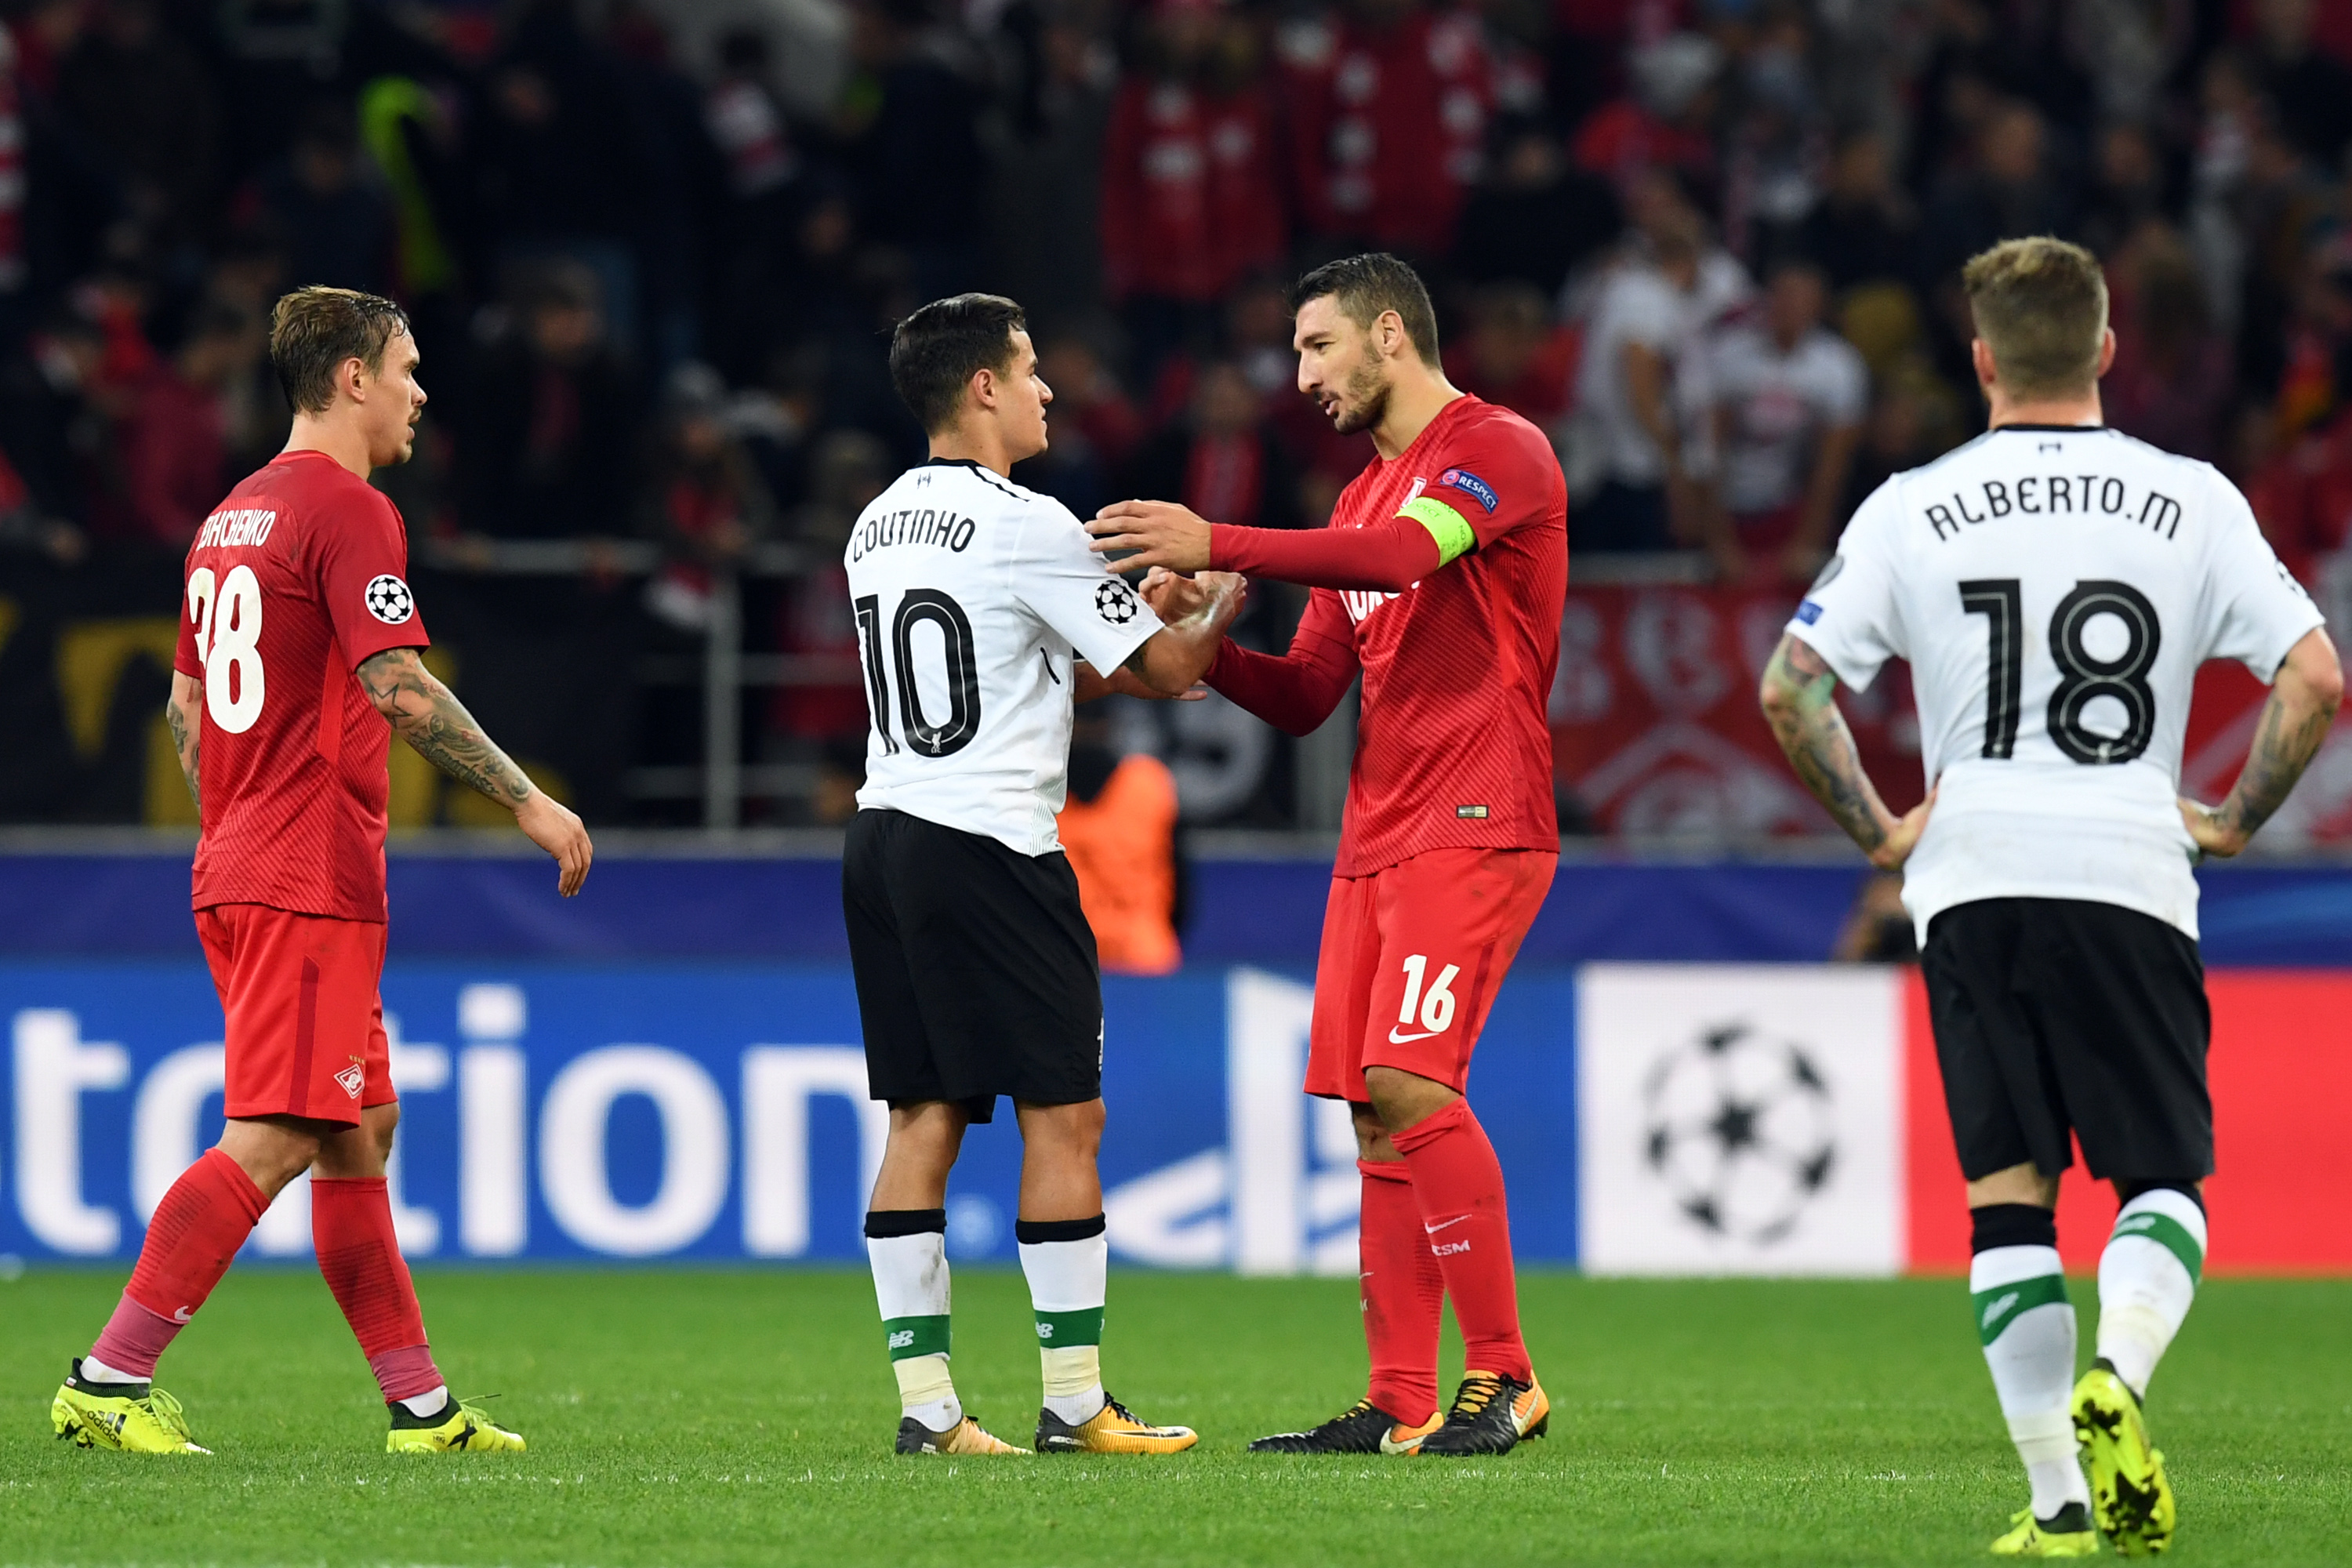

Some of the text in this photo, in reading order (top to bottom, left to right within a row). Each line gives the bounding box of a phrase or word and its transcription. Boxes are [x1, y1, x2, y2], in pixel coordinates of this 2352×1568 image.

[1458, 475, 1497, 509] RESPECT
[1925, 475, 2181, 542] ALBERTO.M
[853, 509, 975, 563] COUTINHO
[855, 588, 981, 757] 10
[1958, 578, 2161, 765] 18
[1398, 953, 1461, 1033] 16
[87, 1410, 122, 1448] adidas
